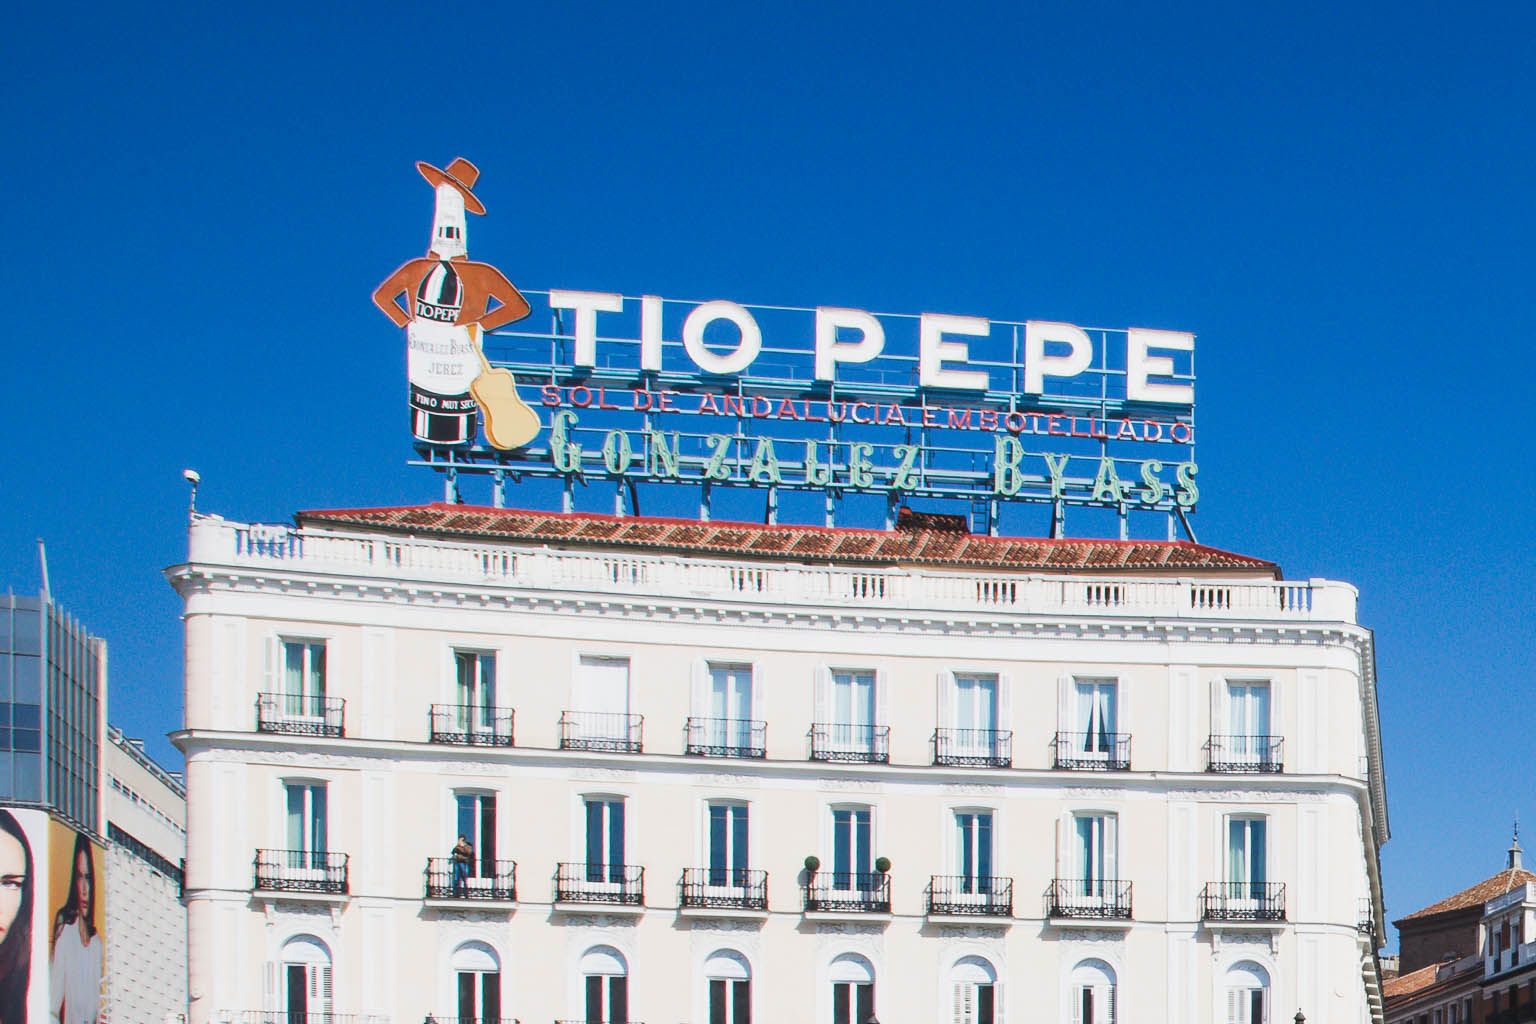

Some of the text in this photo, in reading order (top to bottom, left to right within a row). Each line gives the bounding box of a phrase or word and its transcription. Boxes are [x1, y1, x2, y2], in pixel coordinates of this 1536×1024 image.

[550, 289, 1195, 404] TIO PEPE
[541, 385, 1192, 444] SOL DE ANDALUCIA EMBOTELLADO
[550, 410, 1199, 507] GONZALEZ BYASS
